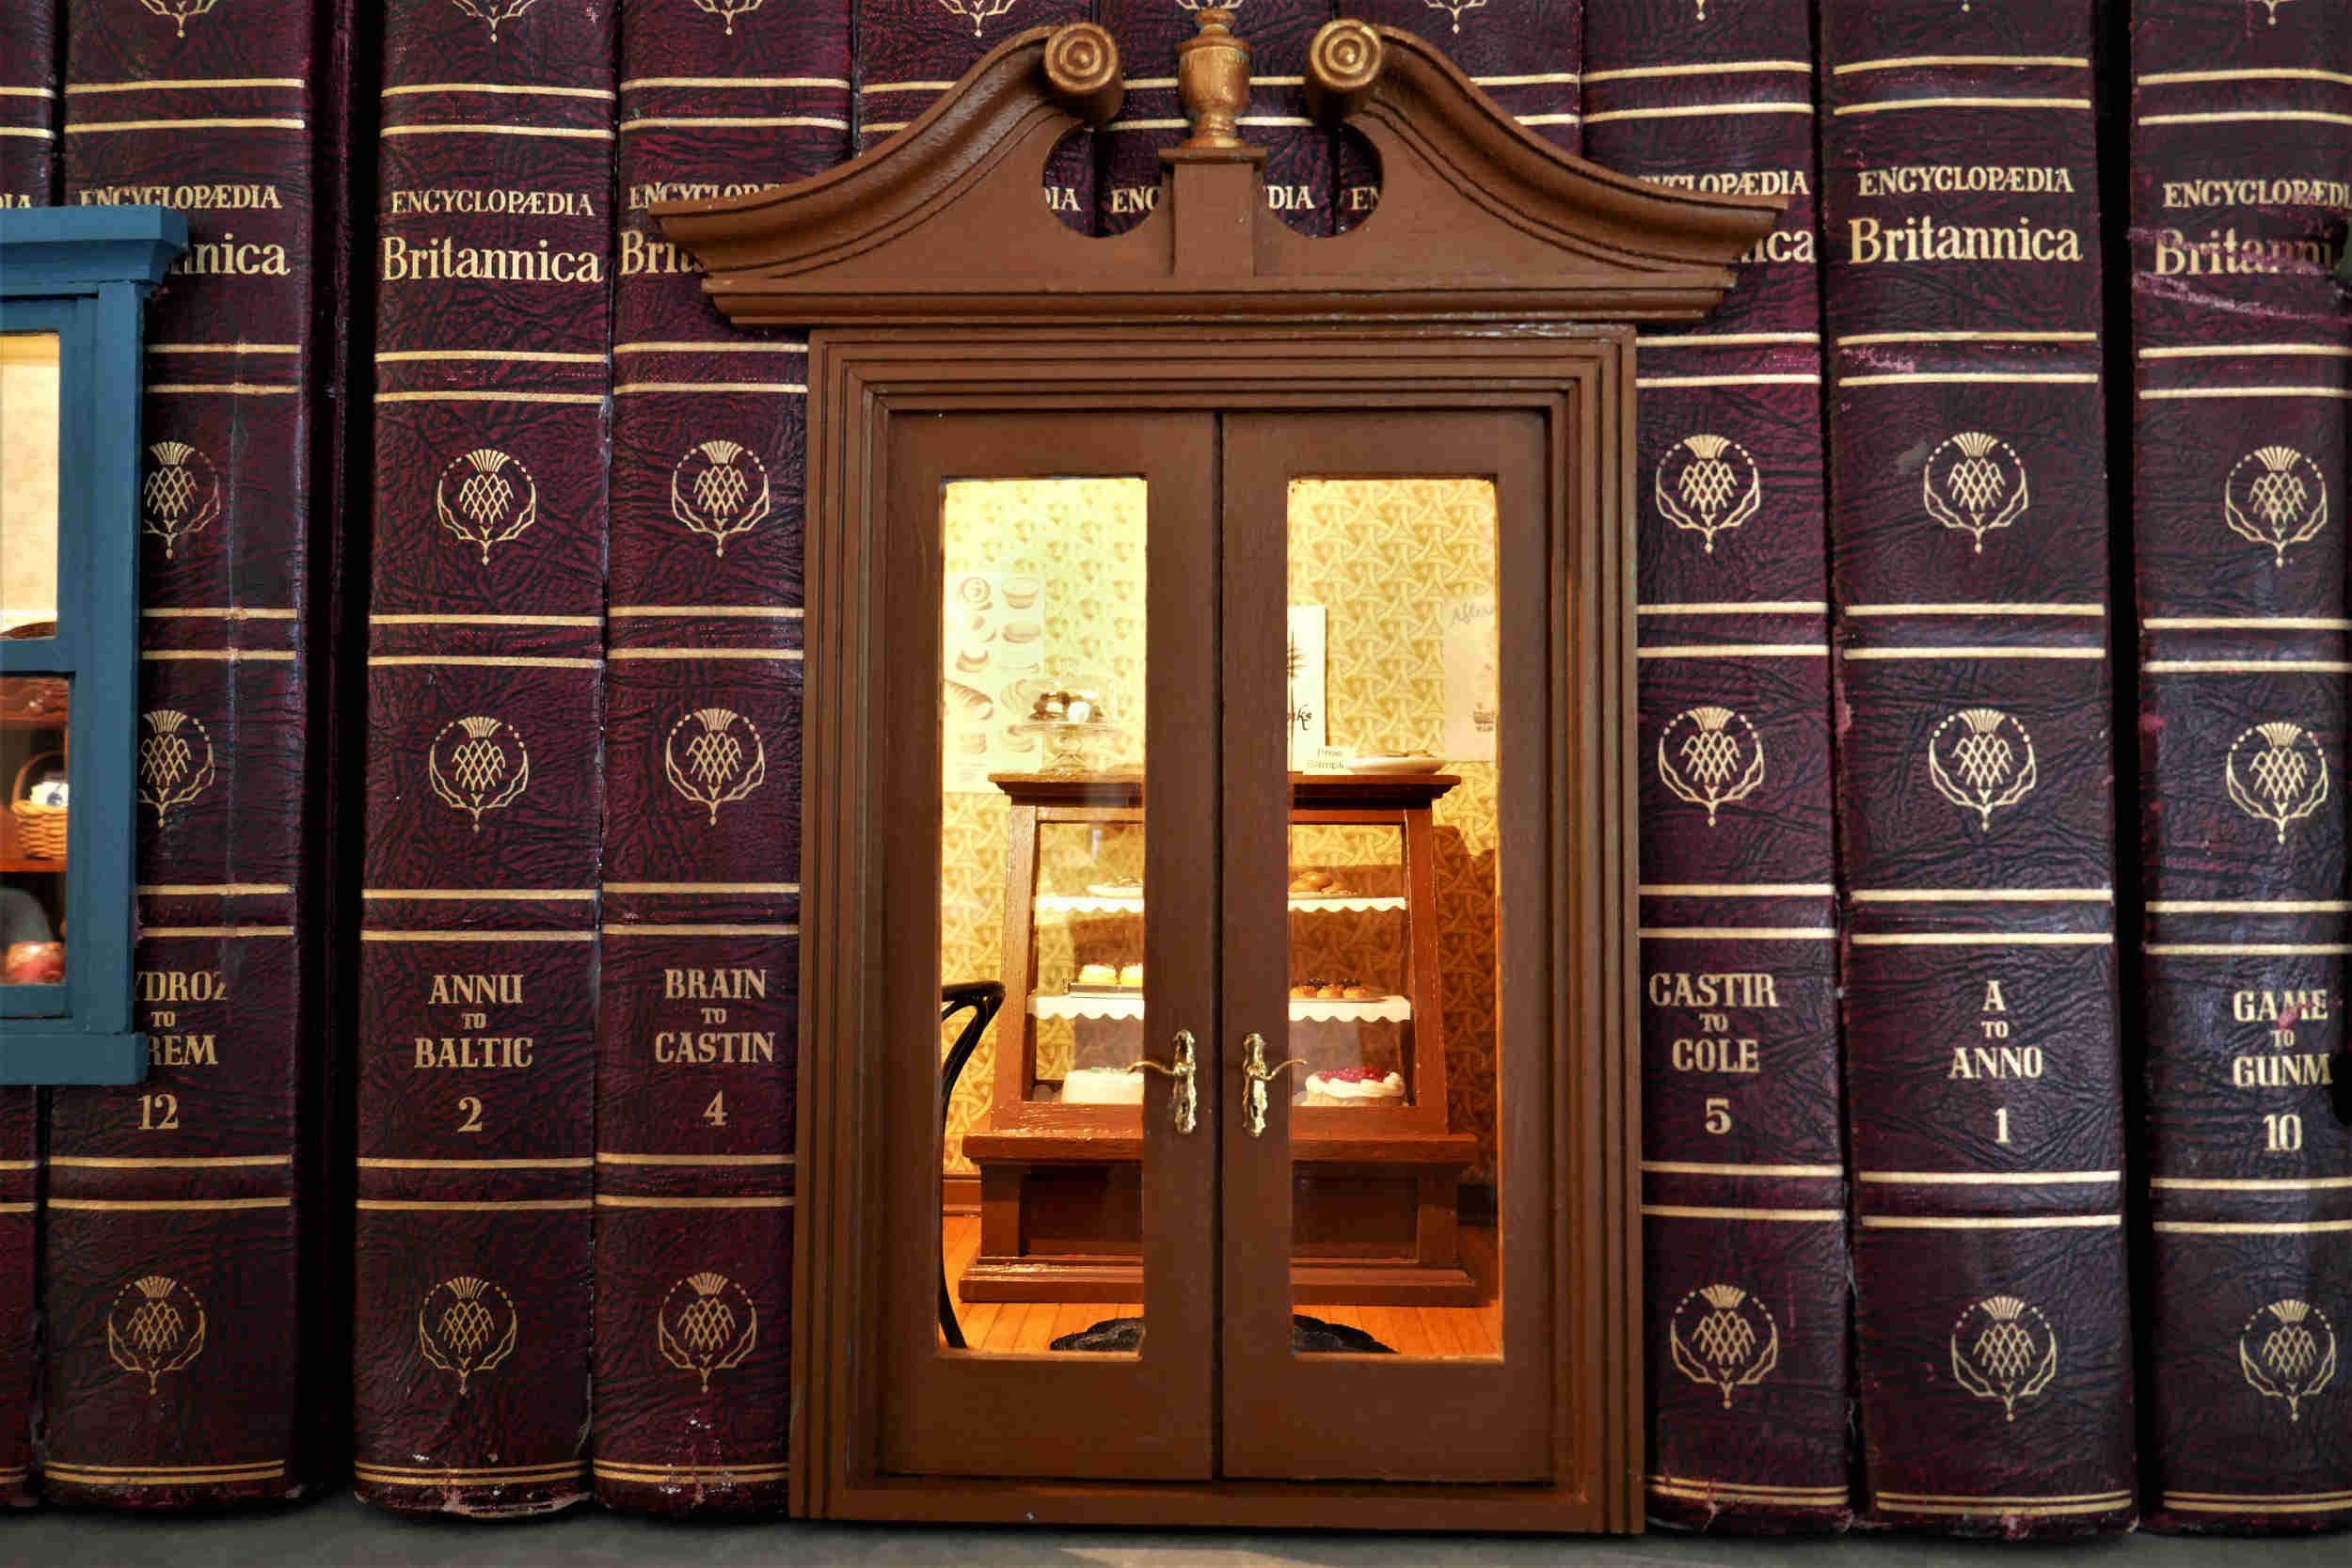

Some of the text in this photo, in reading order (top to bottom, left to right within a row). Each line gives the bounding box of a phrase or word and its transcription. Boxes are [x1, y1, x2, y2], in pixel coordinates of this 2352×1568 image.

[1858, 166, 2074, 197] ENCYCLOPÆDIA
[390, 189, 595, 216] ENCYCLOPÆDIA
[1848, 216, 2083, 264] Britannica
[382, 236, 605, 283] Britannica
[135, 971, 228, 1002] DROZ
[428, 974, 523, 1006] ANNU
[664, 968, 767, 1000] BRAIN
[1648, 973, 1779, 1008] CASTIR
[1982, 981, 2007, 1011] A
[151, 1010, 176, 1028] TO
[461, 1013, 487, 1030] TO
[701, 1008, 728, 1025] TO
[2233, 990, 2328, 1022] GAME
[1698, 1014, 1728, 1033] TO
[1981, 1021, 2009, 1038] TO
[2269, 1030, 2296, 1048] TO
[414, 1037, 533, 1069] BALTIC
[655, 1032, 775, 1064] CASTIN
[1672, 1039, 1760, 1072] COLE
[1948, 1047, 2042, 1080] ANNO
[2233, 1053, 2333, 1087] GUNM
[136, 1093, 180, 1130] 12
[457, 1096, 484, 1132] 2
[703, 1091, 727, 1127] 4
[1705, 1098, 1730, 1134] 5
[1994, 1108, 2010, 1145] 1
[2263, 1113, 2303, 1152] 10
